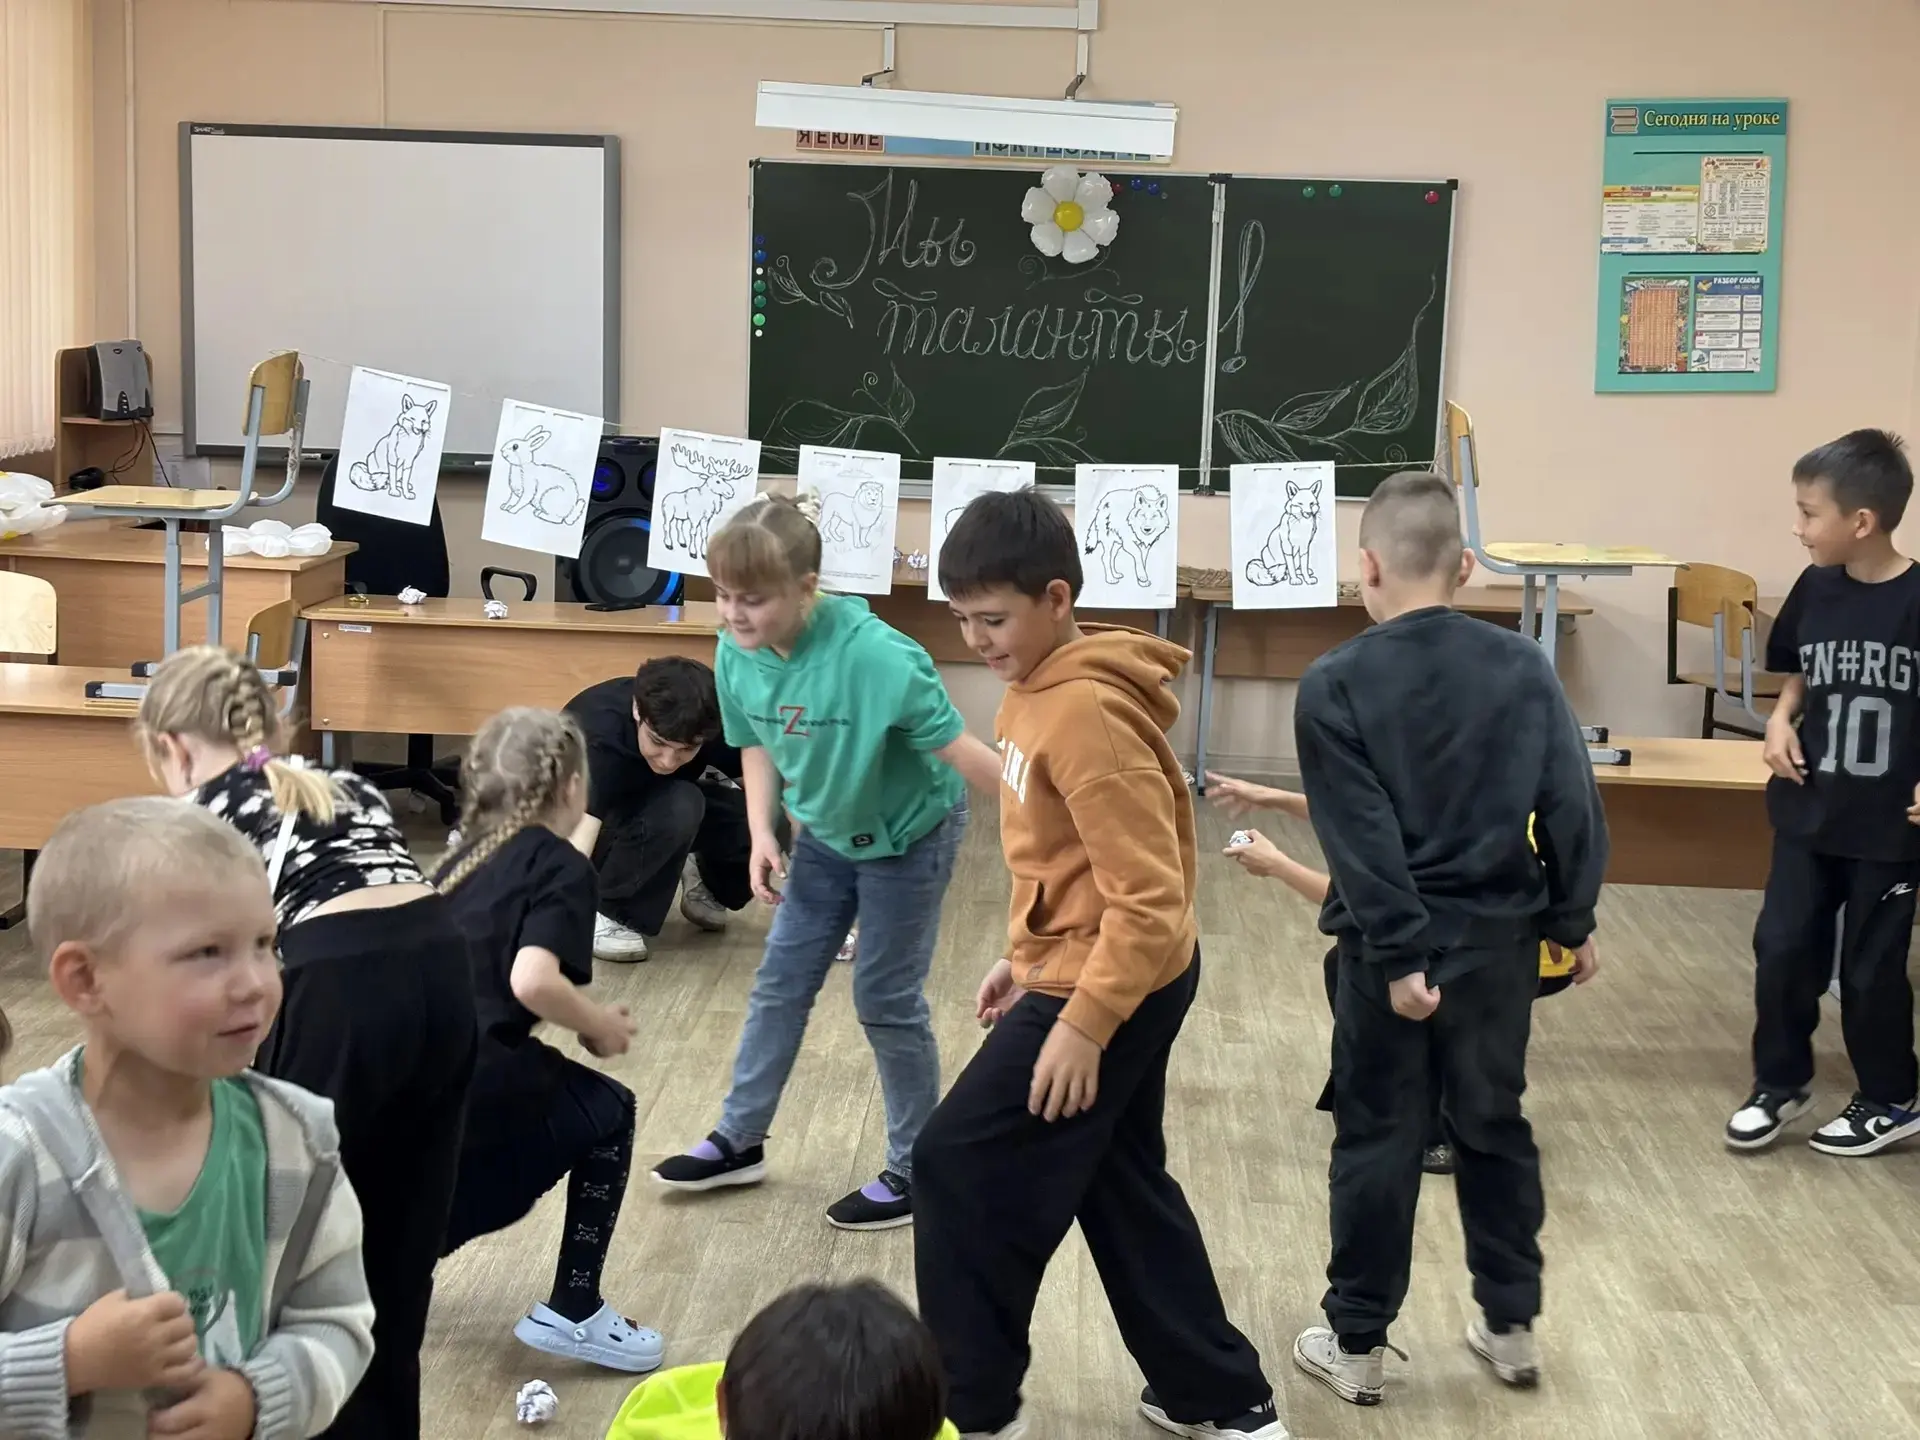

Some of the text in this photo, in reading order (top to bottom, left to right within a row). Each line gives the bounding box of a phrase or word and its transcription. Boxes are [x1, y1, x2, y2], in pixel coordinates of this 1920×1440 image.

[1643, 110, 1780, 131] Сегодня на уроке
[810, 168, 977, 290] Мы
[1739, 276, 1760, 284] СЛОВА
[778, 705, 811, 737] Z
[1818, 693, 1892, 777] 10
